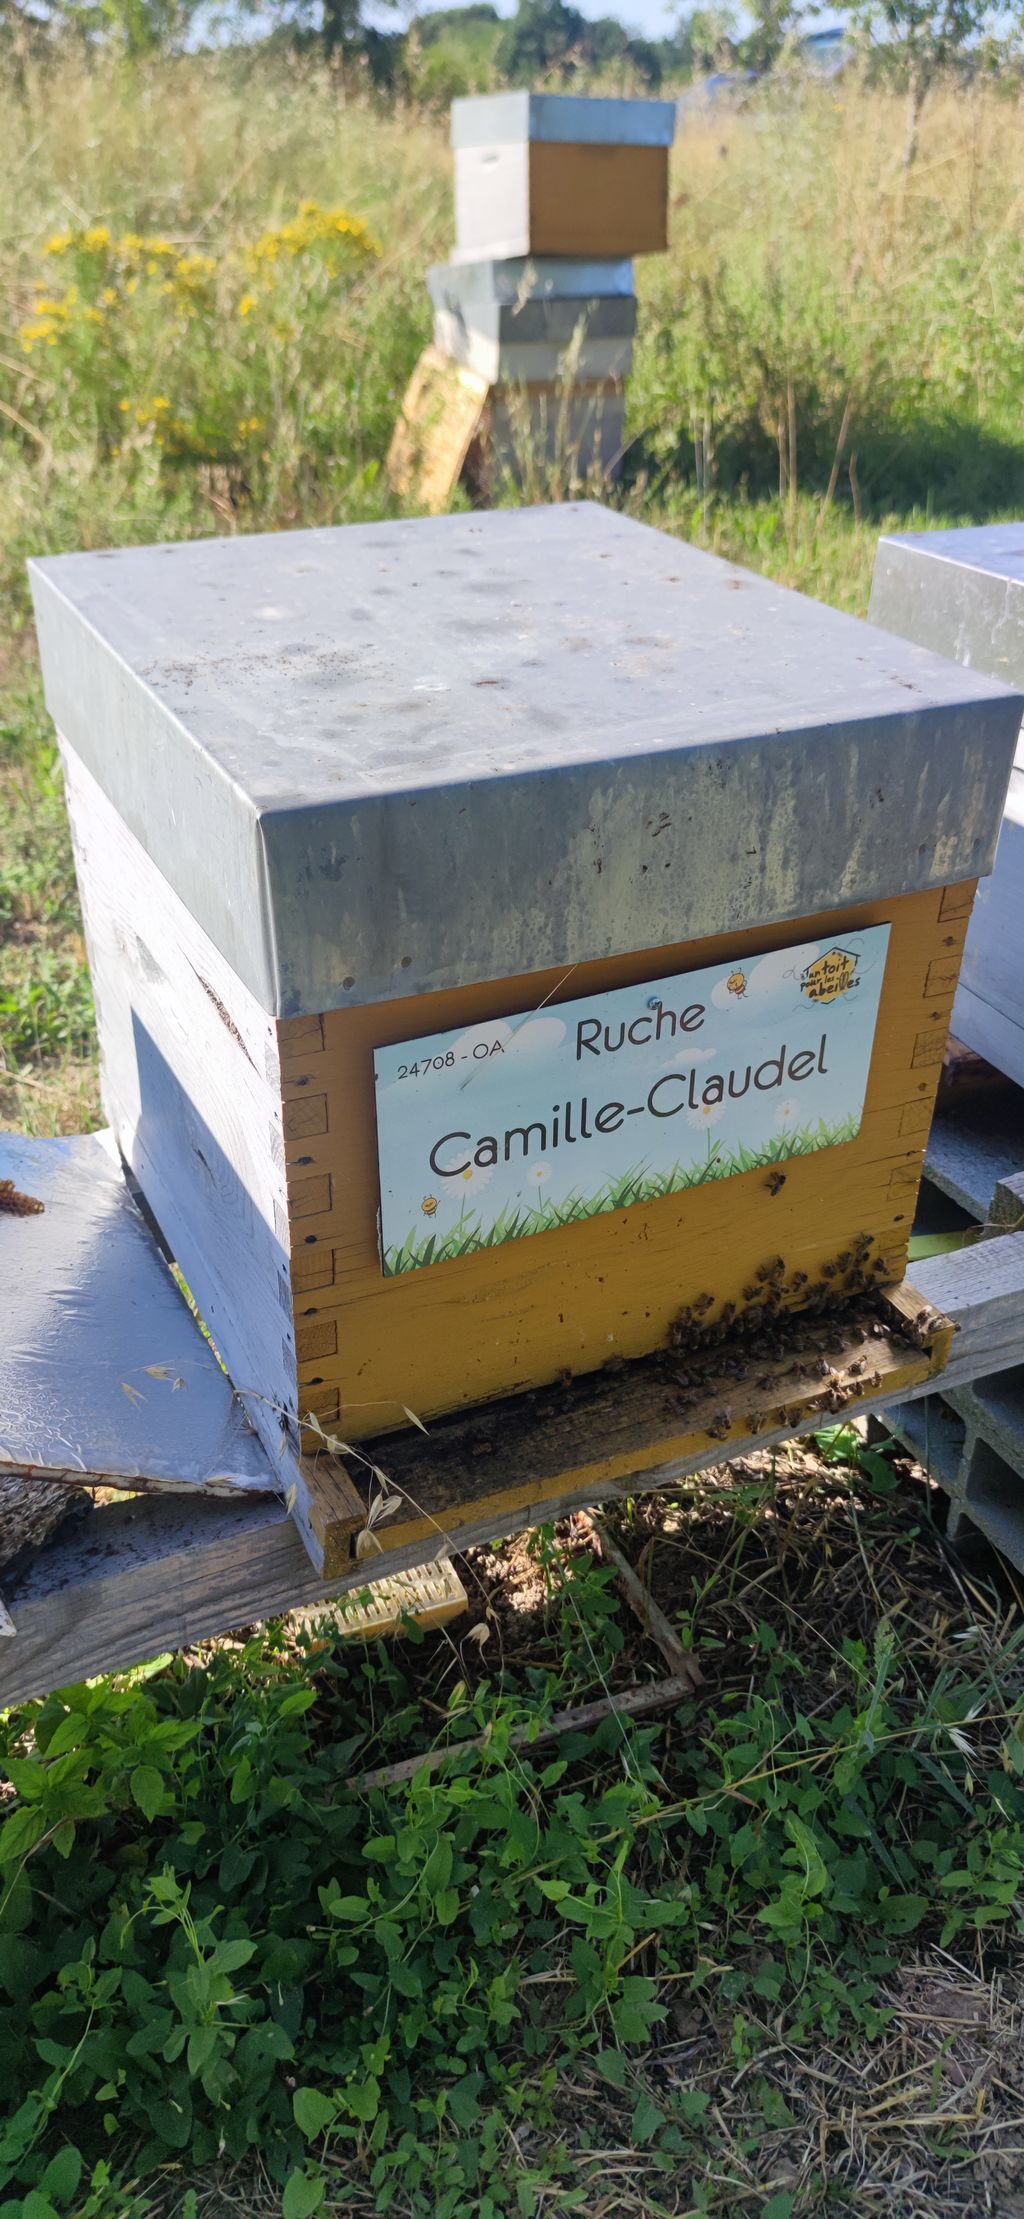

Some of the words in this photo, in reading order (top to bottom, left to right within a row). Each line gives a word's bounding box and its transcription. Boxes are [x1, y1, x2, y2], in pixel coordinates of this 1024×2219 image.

[822, 956, 849, 975] toit
[800, 976, 822, 992] pour
[824, 975, 835, 984] les
[808, 971, 861, 998] abeilles
[576, 1000, 706, 1061] Ruche
[397, 1051, 455, 1080] 24708
[473, 1039, 505, 1059] OA
[429, 1033, 829, 1178] Camille-Claudel
